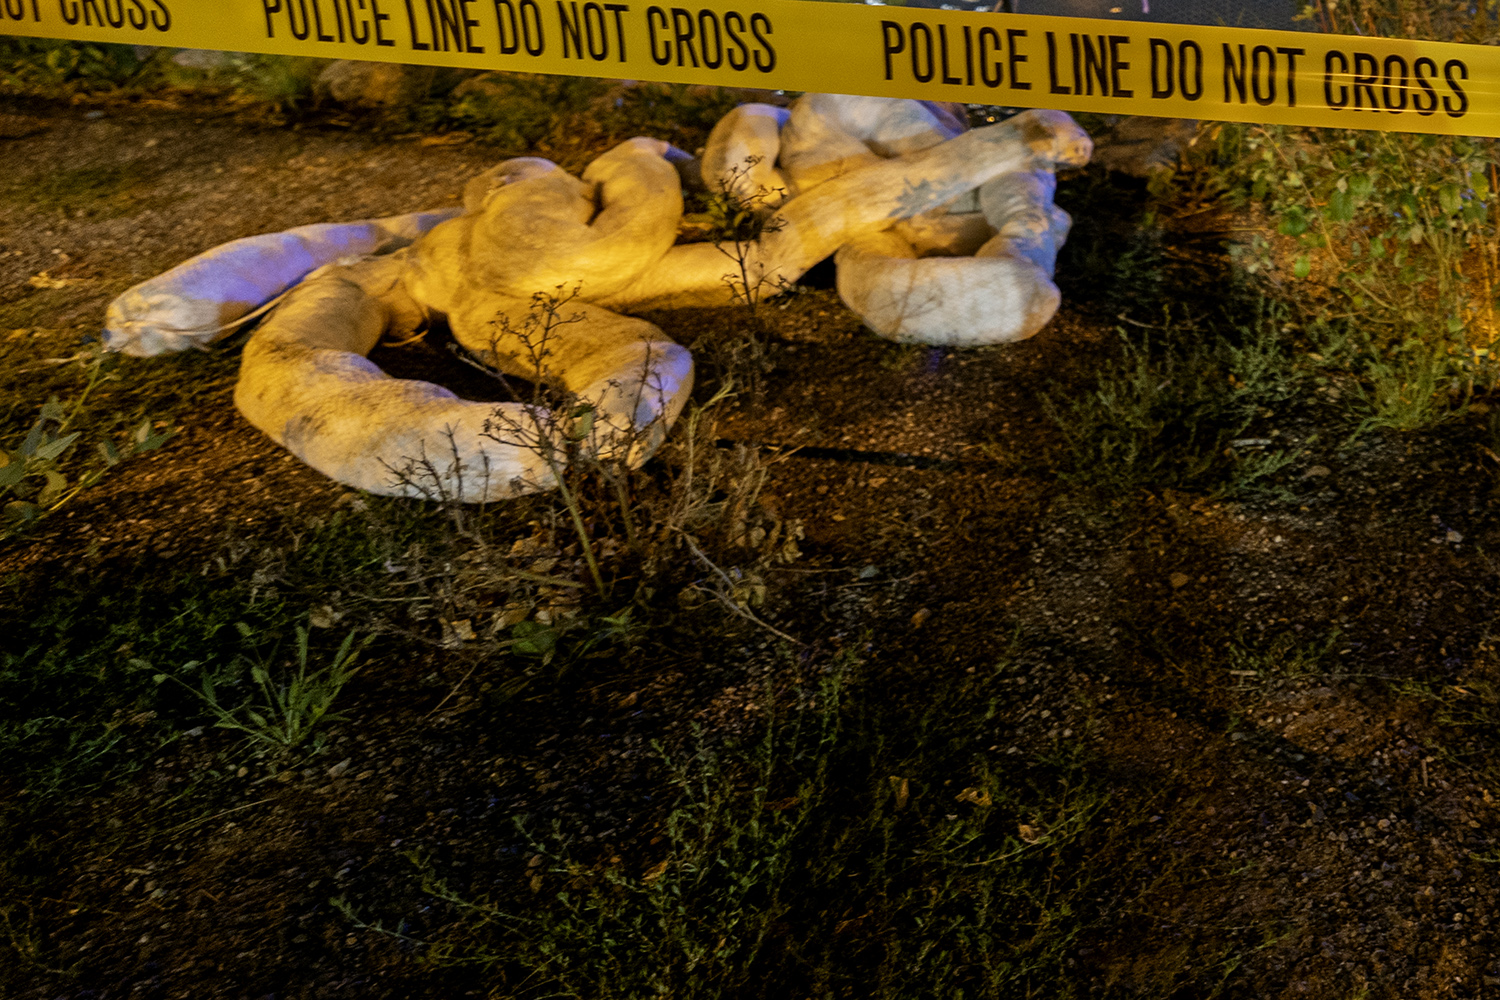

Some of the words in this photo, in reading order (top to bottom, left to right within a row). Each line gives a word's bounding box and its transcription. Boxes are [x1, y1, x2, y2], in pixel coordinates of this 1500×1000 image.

[558, 1, 629, 63] NOT
[646, 5, 777, 73] CROSS
[880, 20, 1032, 90] POLICE
[1044, 31, 1134, 98] LINE
[1149, 38, 1202, 100] DO
[1222, 42, 1306, 107] NOT
[1323, 50, 1469, 117] CROSS
